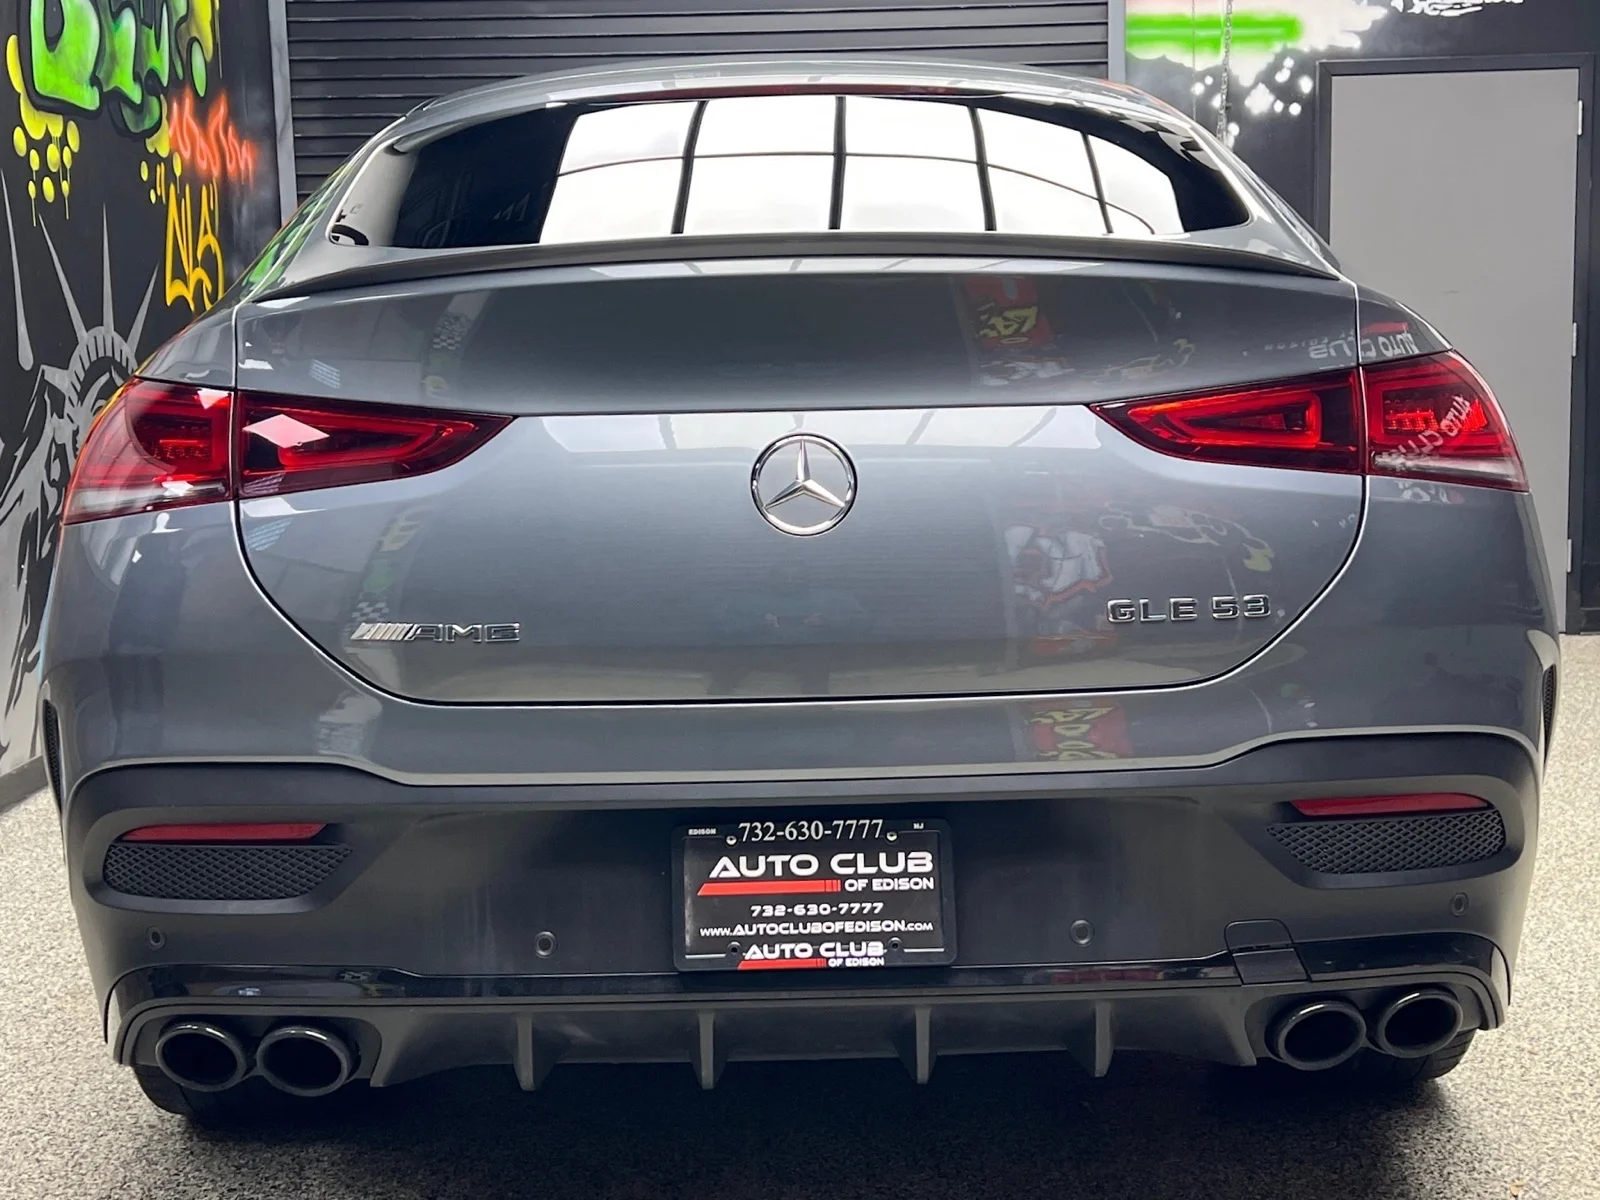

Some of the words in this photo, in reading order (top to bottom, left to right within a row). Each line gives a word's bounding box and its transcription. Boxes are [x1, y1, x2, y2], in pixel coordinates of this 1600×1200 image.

[1107, 597, 1198, 623] GLE
[1211, 593, 1272, 620] 53
[403, 623, 520, 642] AMG
[688, 828, 717, 836] EDISON
[738, 819, 884, 842] 732-630-7777
[709, 854, 819, 878] AUTO
[830, 851, 934, 875] CLUB
[844, 879, 869, 892] OF
[872, 877, 934, 891] EDISON
[750, 902, 884, 917] 732-630-7777
[744, 942, 813, 960] AUTO
[819, 941, 884, 957] CLUB
[828, 958, 844, 967] OF
[845, 957, 885, 967] EDISON
